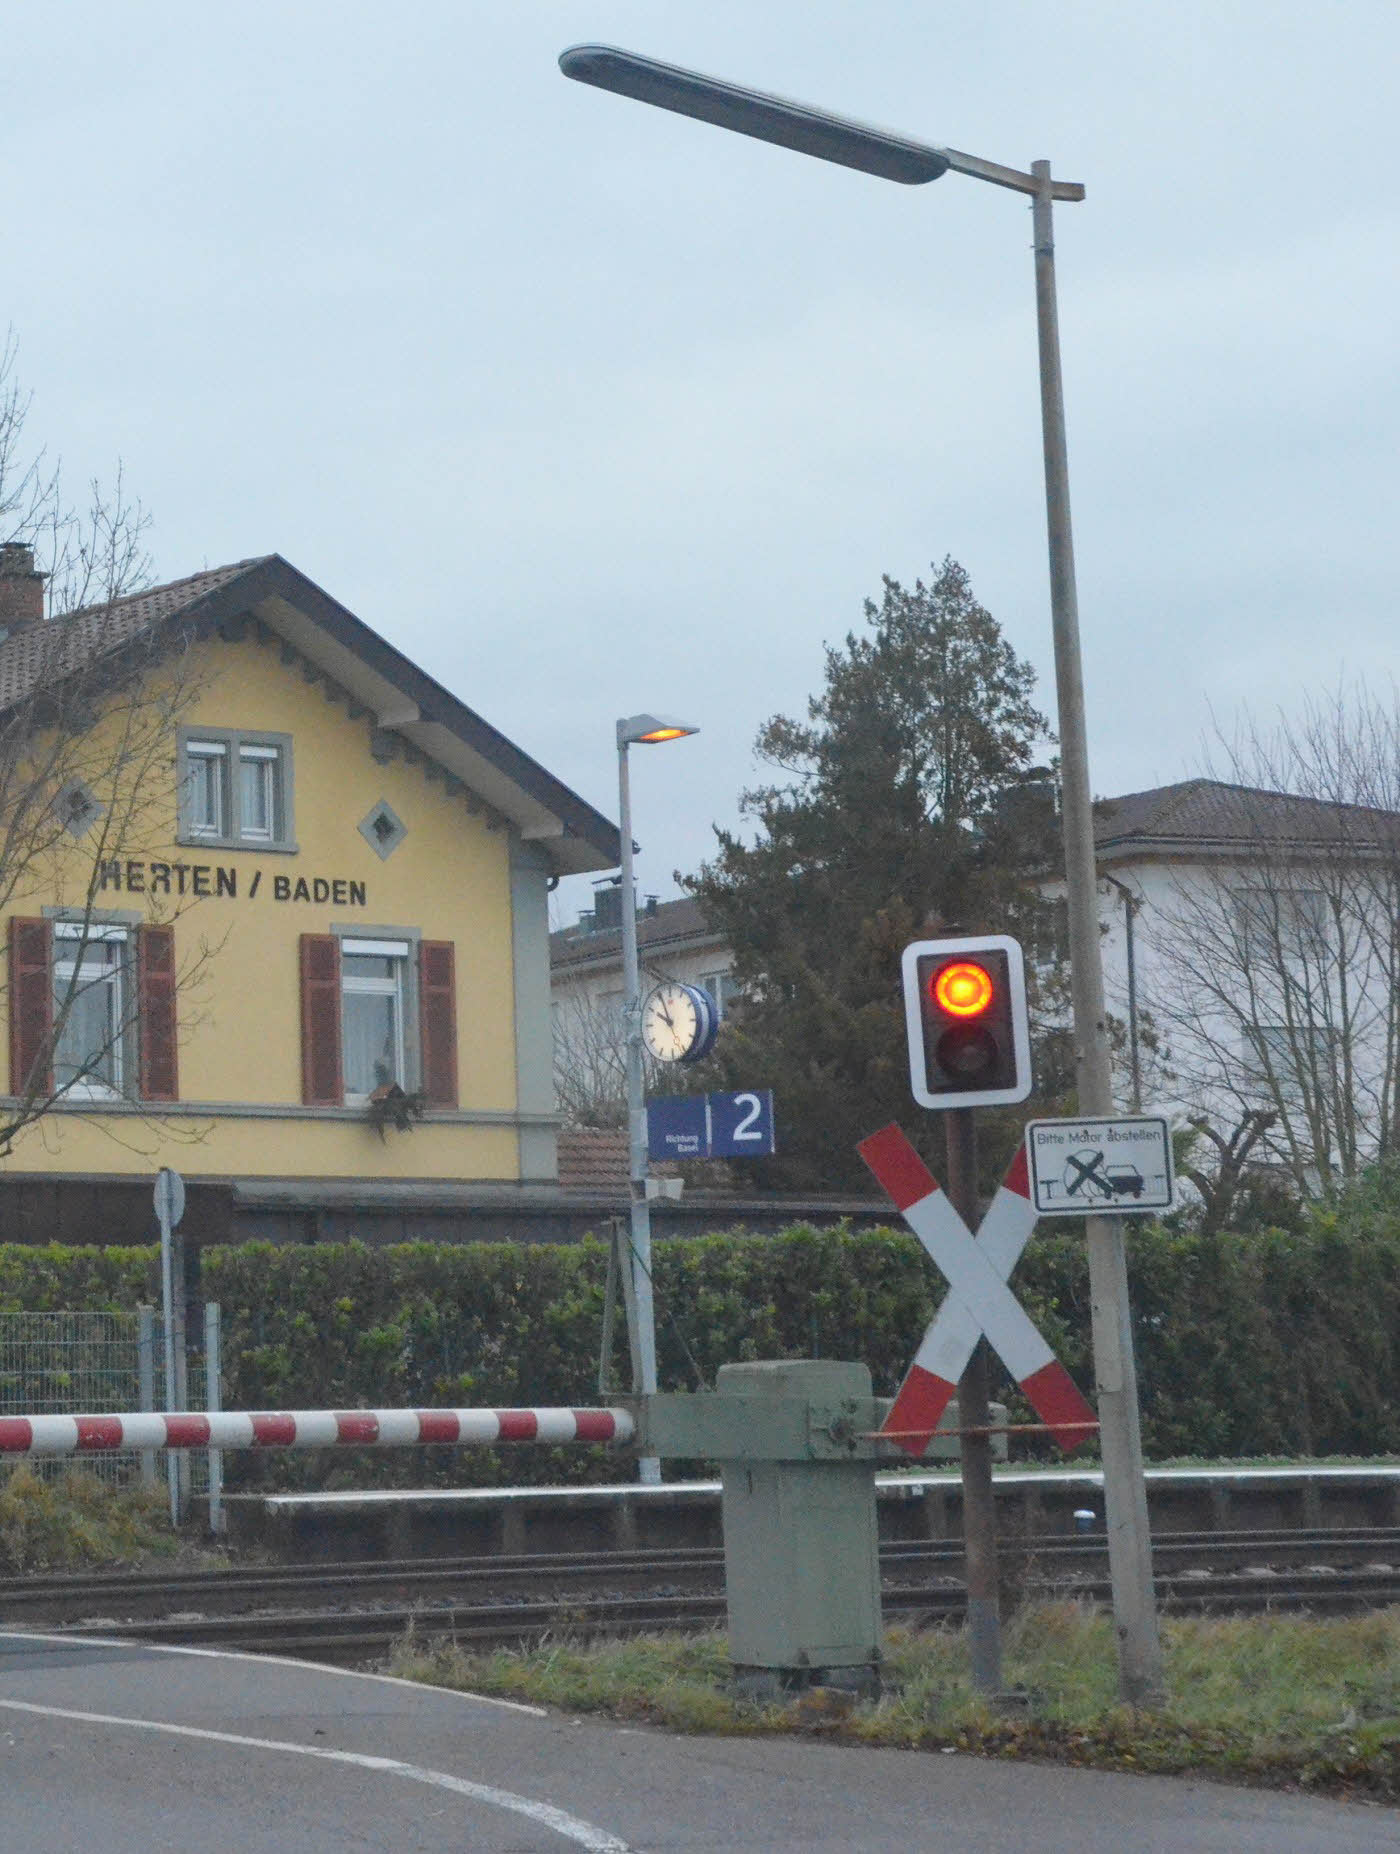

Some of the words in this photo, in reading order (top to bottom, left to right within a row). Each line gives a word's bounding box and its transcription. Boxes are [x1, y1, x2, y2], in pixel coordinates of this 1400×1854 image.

[100, 860, 237, 898] HERTEN
[249, 870, 262, 898] /
[274, 875, 367, 906] BADEN
[733, 1093, 762, 1140] 2
[665, 1134, 698, 1144] Richtung
[1037, 1133, 1064, 1145] Bitte
[1069, 1131, 1102, 1144] Motor
[1107, 1129, 1161, 1143] abstellen
[677, 1144, 698, 1153] Basel
